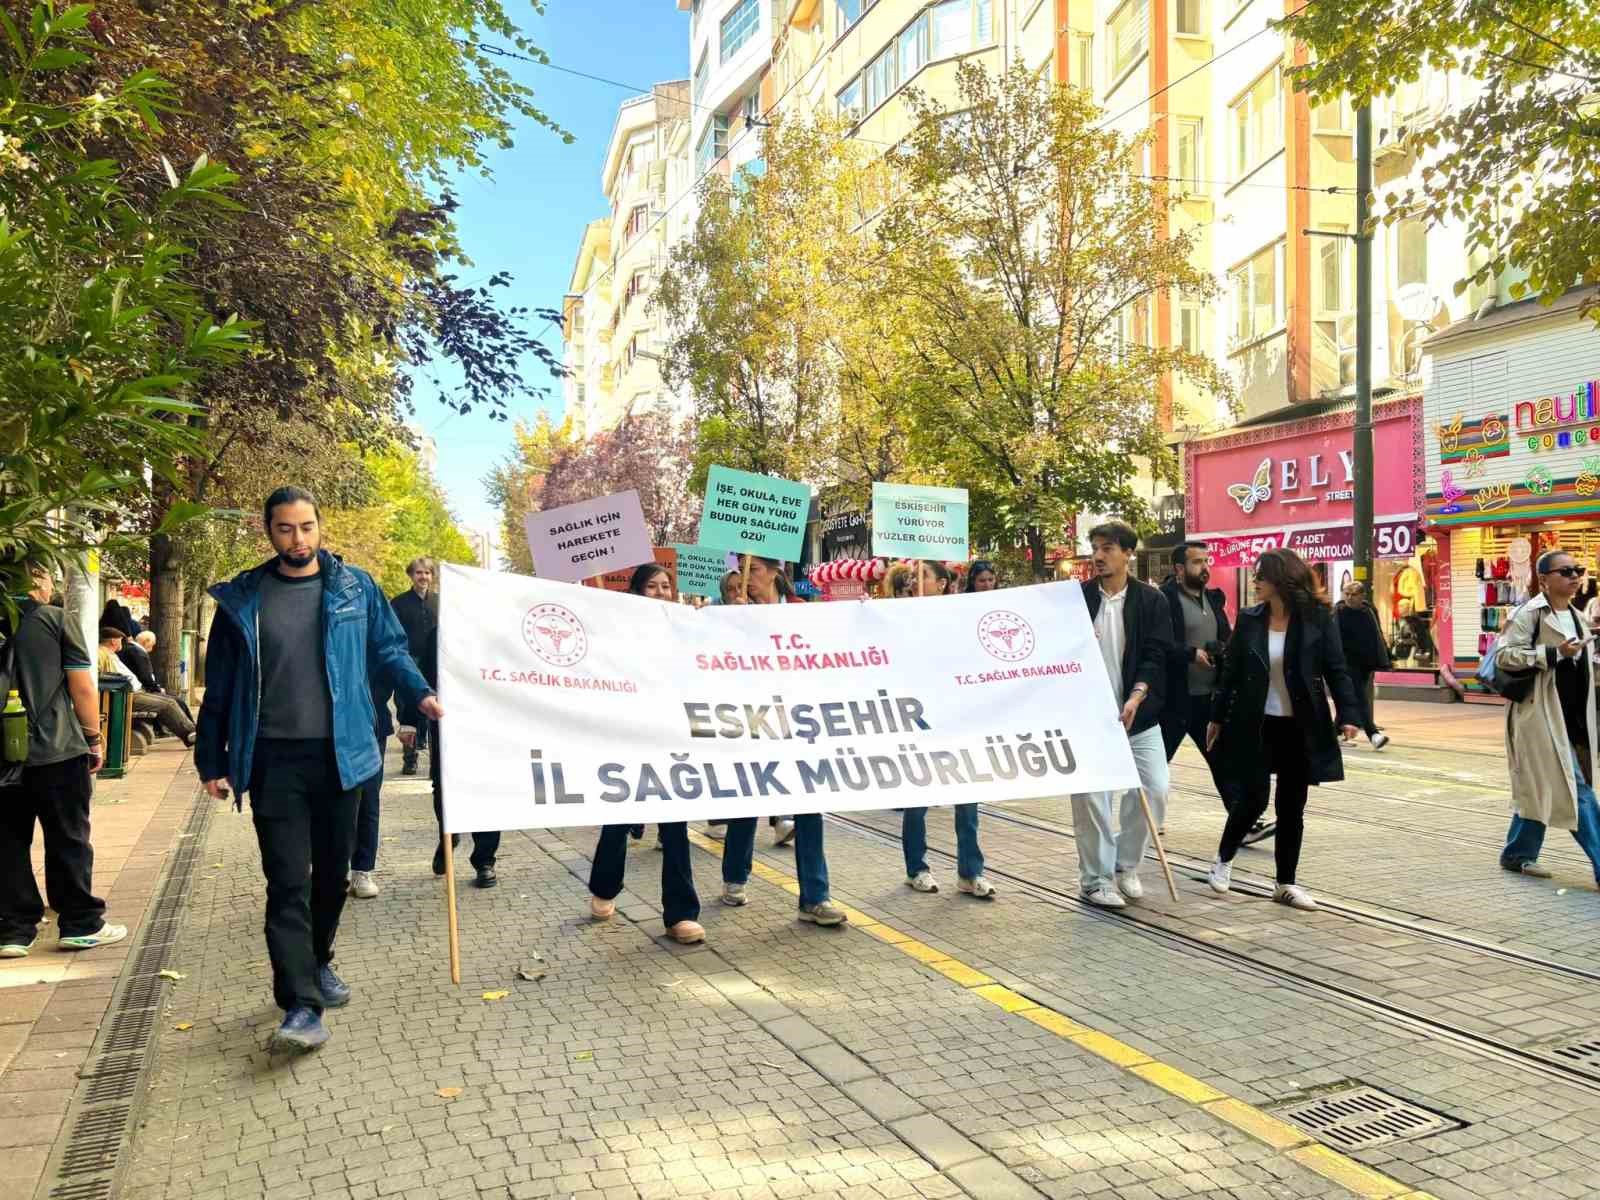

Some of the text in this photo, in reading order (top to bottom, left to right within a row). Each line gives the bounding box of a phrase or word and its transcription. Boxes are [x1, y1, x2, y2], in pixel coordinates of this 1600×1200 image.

[716, 481, 802, 507] İŞE, OKULA, EVE
[716, 498, 797, 519] HER GÜN YÜRÜ
[895, 501, 947, 513] ESKİŞEHİR
[549, 511, 621, 536] SAĞLIK İÇİN
[710, 511, 799, 534] BUDUR SAĞLIĞIN
[897, 517, 945, 528] YÜRÜYOR
[557, 528, 621, 550] HAREKETE
[741, 530, 766, 543] ÖZÜ!
[877, 531, 965, 545] YÜZLER GÜLÜYOR
[1296, 534, 1325, 544] 2 ADET
[571, 547, 608, 563] GEÇİN
[1309, 544, 1354, 559] PANTOLON
[770, 633, 811, 650] T.C.
[695, 646, 890, 672] SAĞLIK BAKANLIĞI
[479, 668, 638, 693] T.C. SAĞLIK BAKANLIĞI
[954, 661, 1082, 685] T.C. SAĞLIK BAKANLIĞI
[683, 689, 932, 744] ESKİŞEHİR
[531, 729, 1077, 804] İL SAĞLIK MÜDÜRLÜĞÜ
